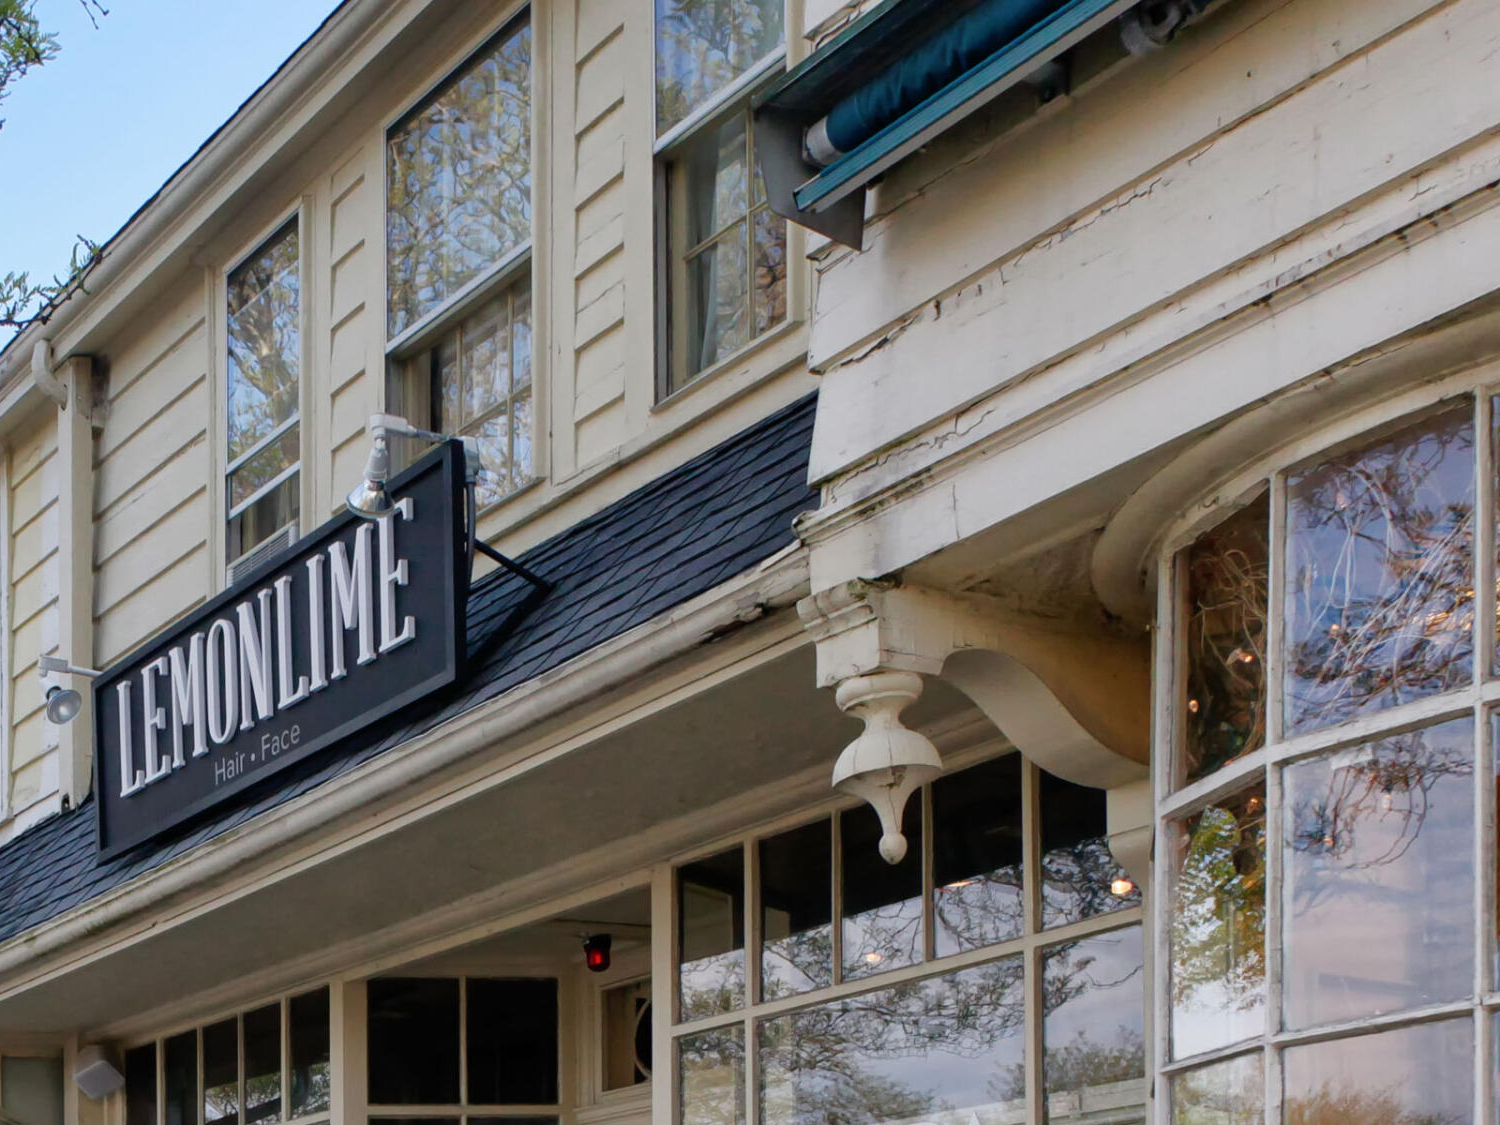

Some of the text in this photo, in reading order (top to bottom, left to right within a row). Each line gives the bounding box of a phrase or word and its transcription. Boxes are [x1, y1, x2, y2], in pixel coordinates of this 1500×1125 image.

[116, 497, 416, 799] LEMONLIME
[214, 725, 301, 786] Hair Face
